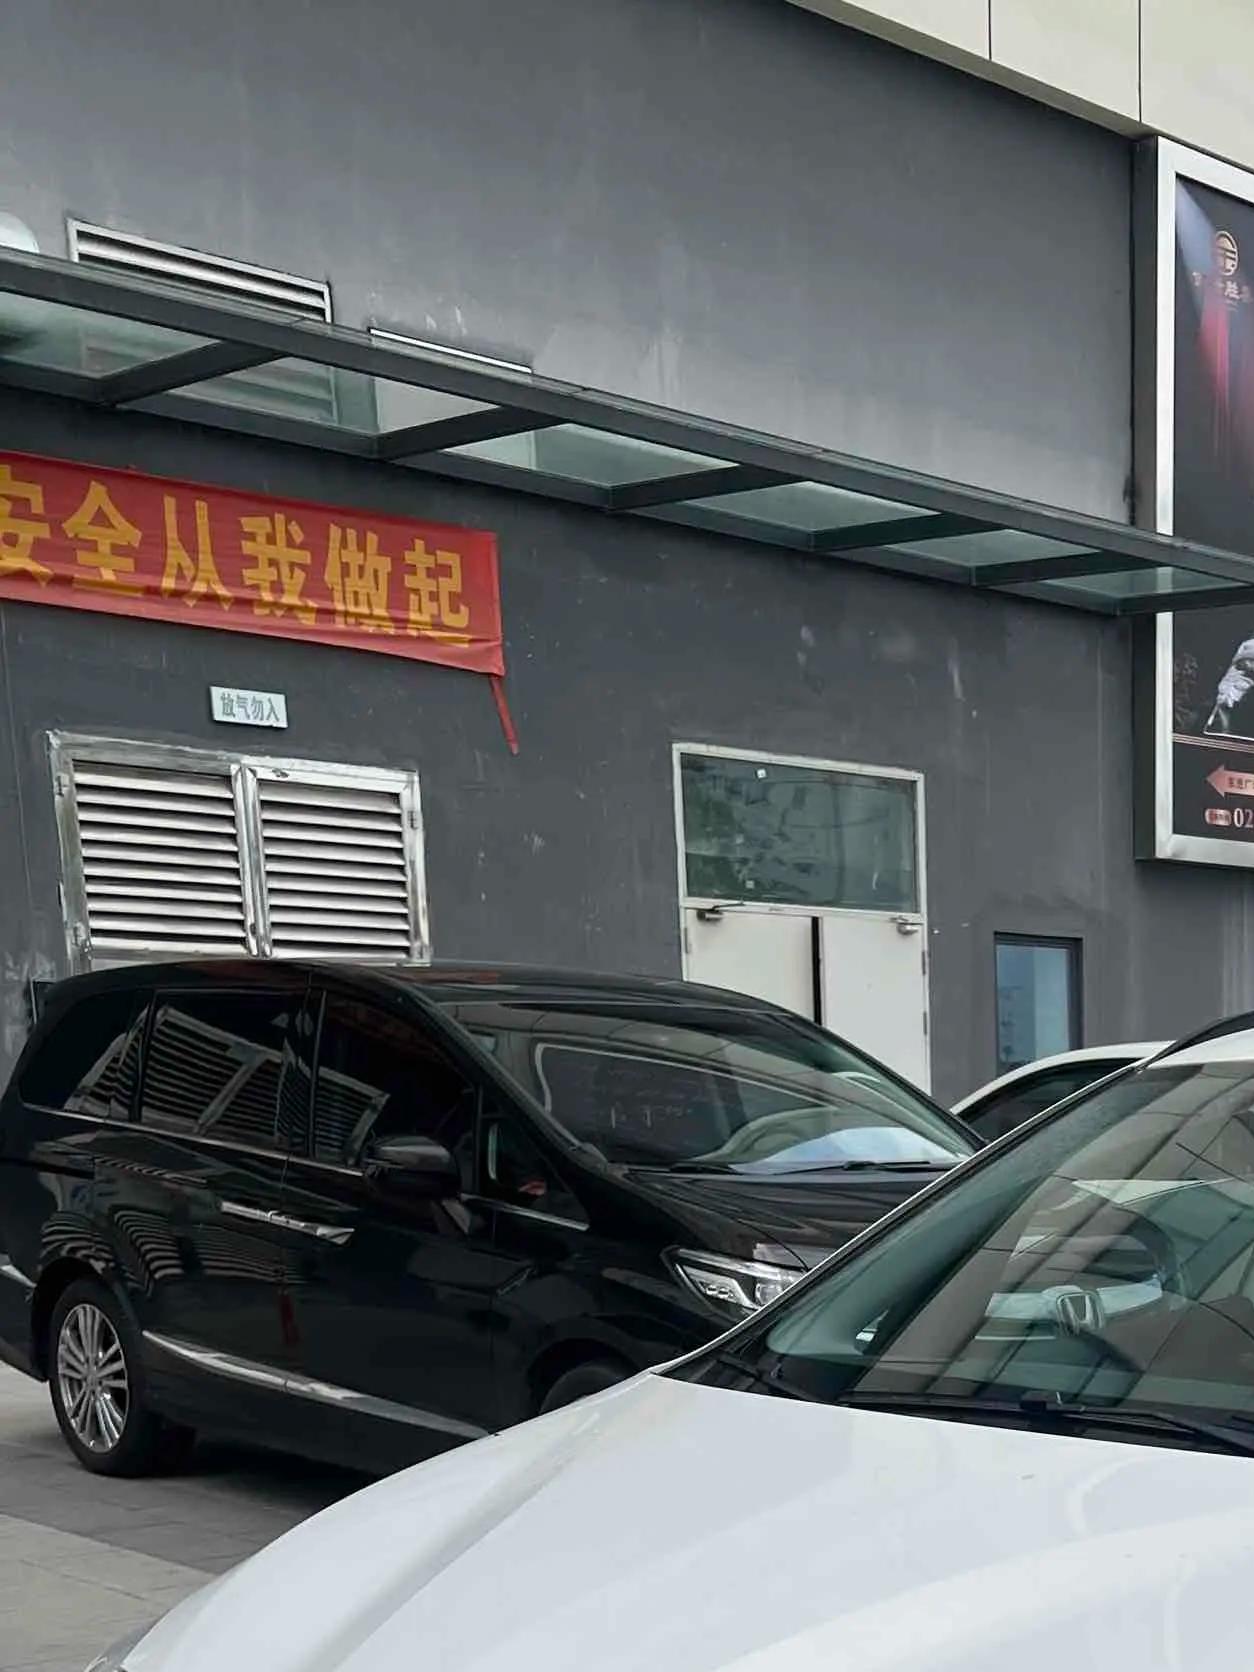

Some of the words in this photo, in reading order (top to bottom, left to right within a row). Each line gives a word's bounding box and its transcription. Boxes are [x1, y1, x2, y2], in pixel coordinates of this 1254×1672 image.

[0, 465, 470, 648] 安全从我做起
